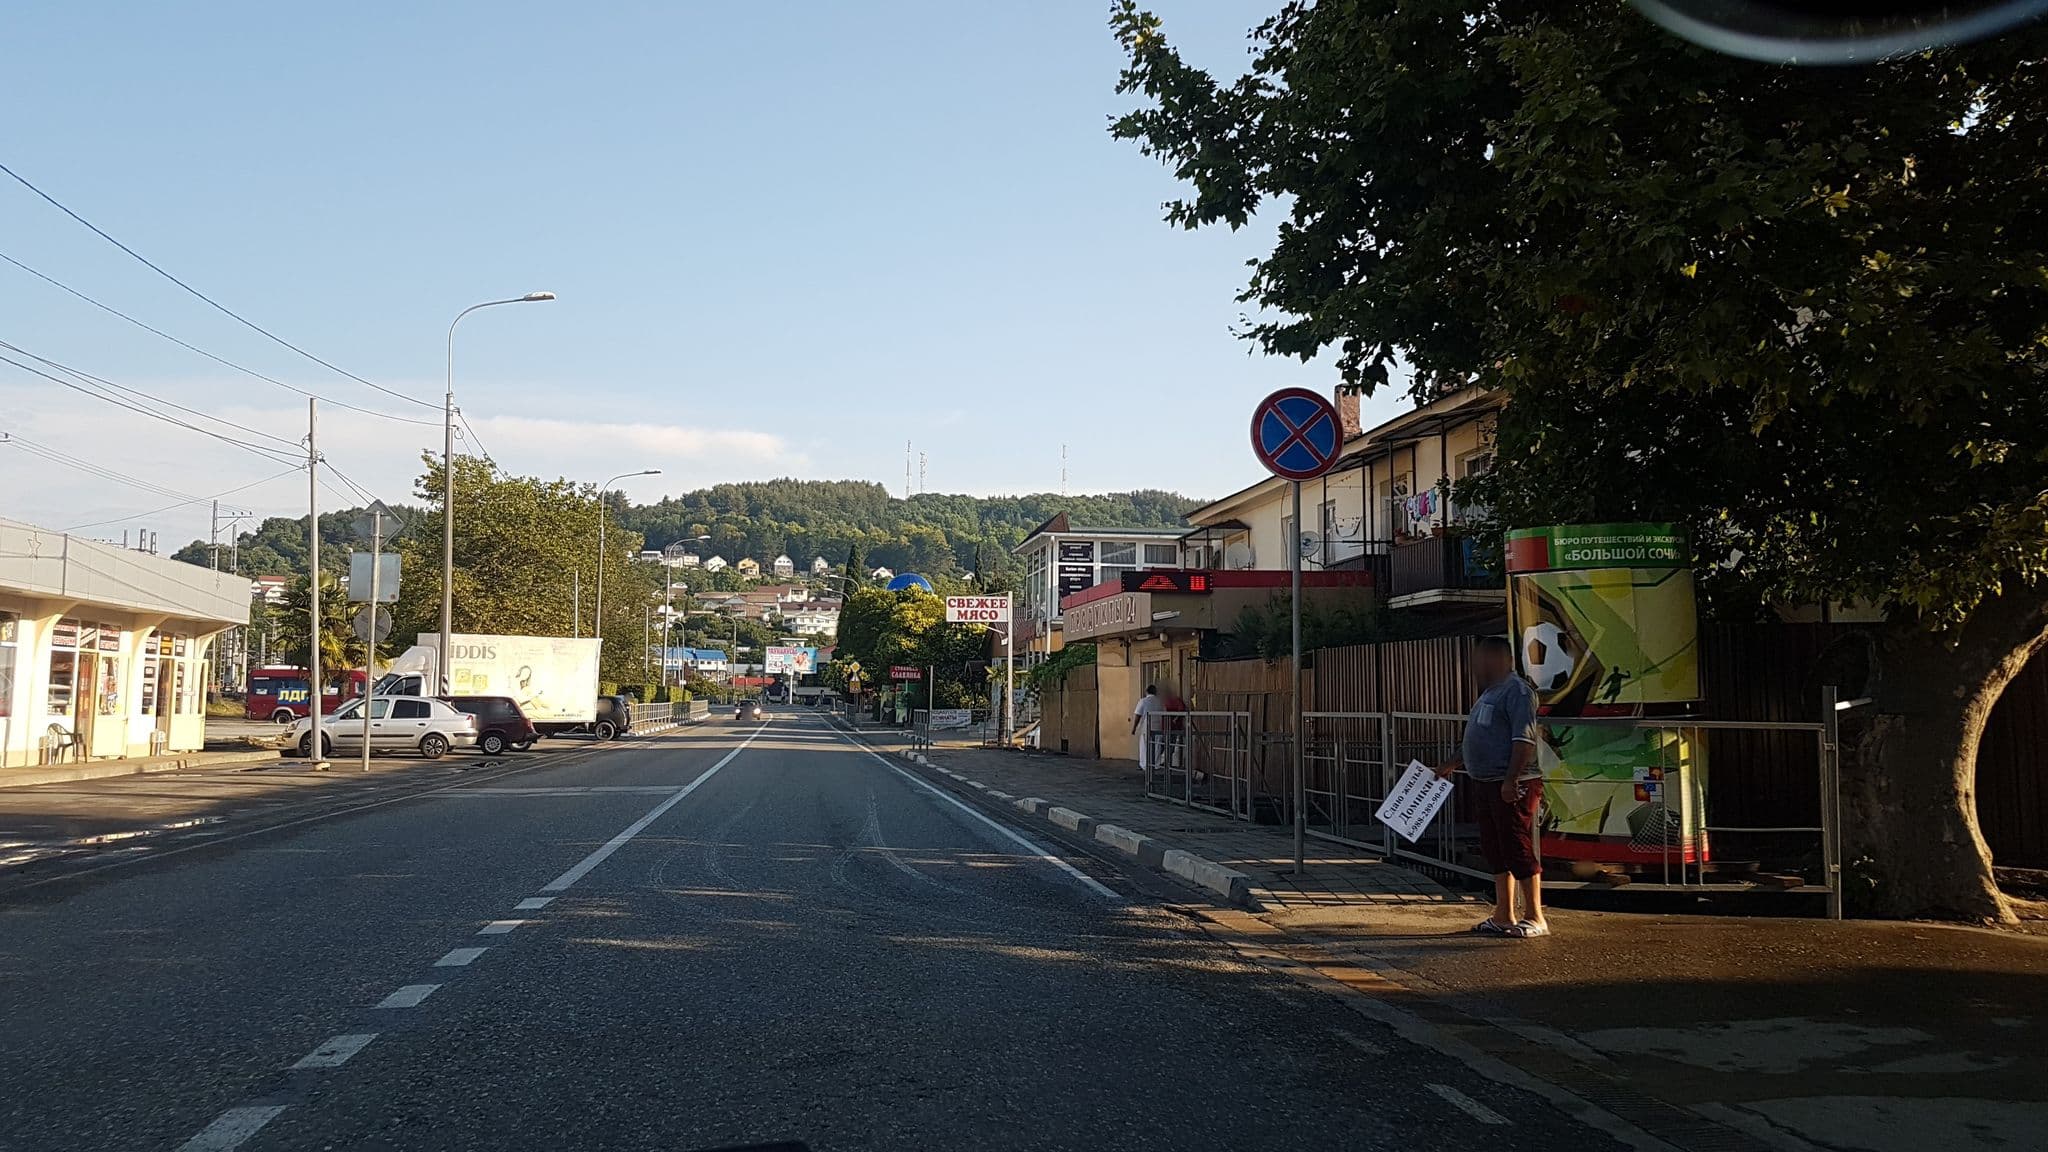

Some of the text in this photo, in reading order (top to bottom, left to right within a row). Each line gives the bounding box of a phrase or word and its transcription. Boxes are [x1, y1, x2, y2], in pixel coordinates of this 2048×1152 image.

[1554, 537, 1580, 546] БЮРО
[1581, 534, 1645, 545] ПУТЕШЕСТВИЙ
[1646, 535, 1652, 543] И
[1564, 546, 1645, 561] «БОЛЬШОЙ
[948, 598, 1008, 608] СВЕЖЕЕ
[957, 610, 998, 620] МЯСО
[1070, 597, 1136, 633] ПРОДУКТЫ 24
[1383, 765, 1424, 819] Сдаю жильё
[1398, 780, 1434, 825] Домики
[1407, 782, 1448, 837] 8-988-289-90-09
